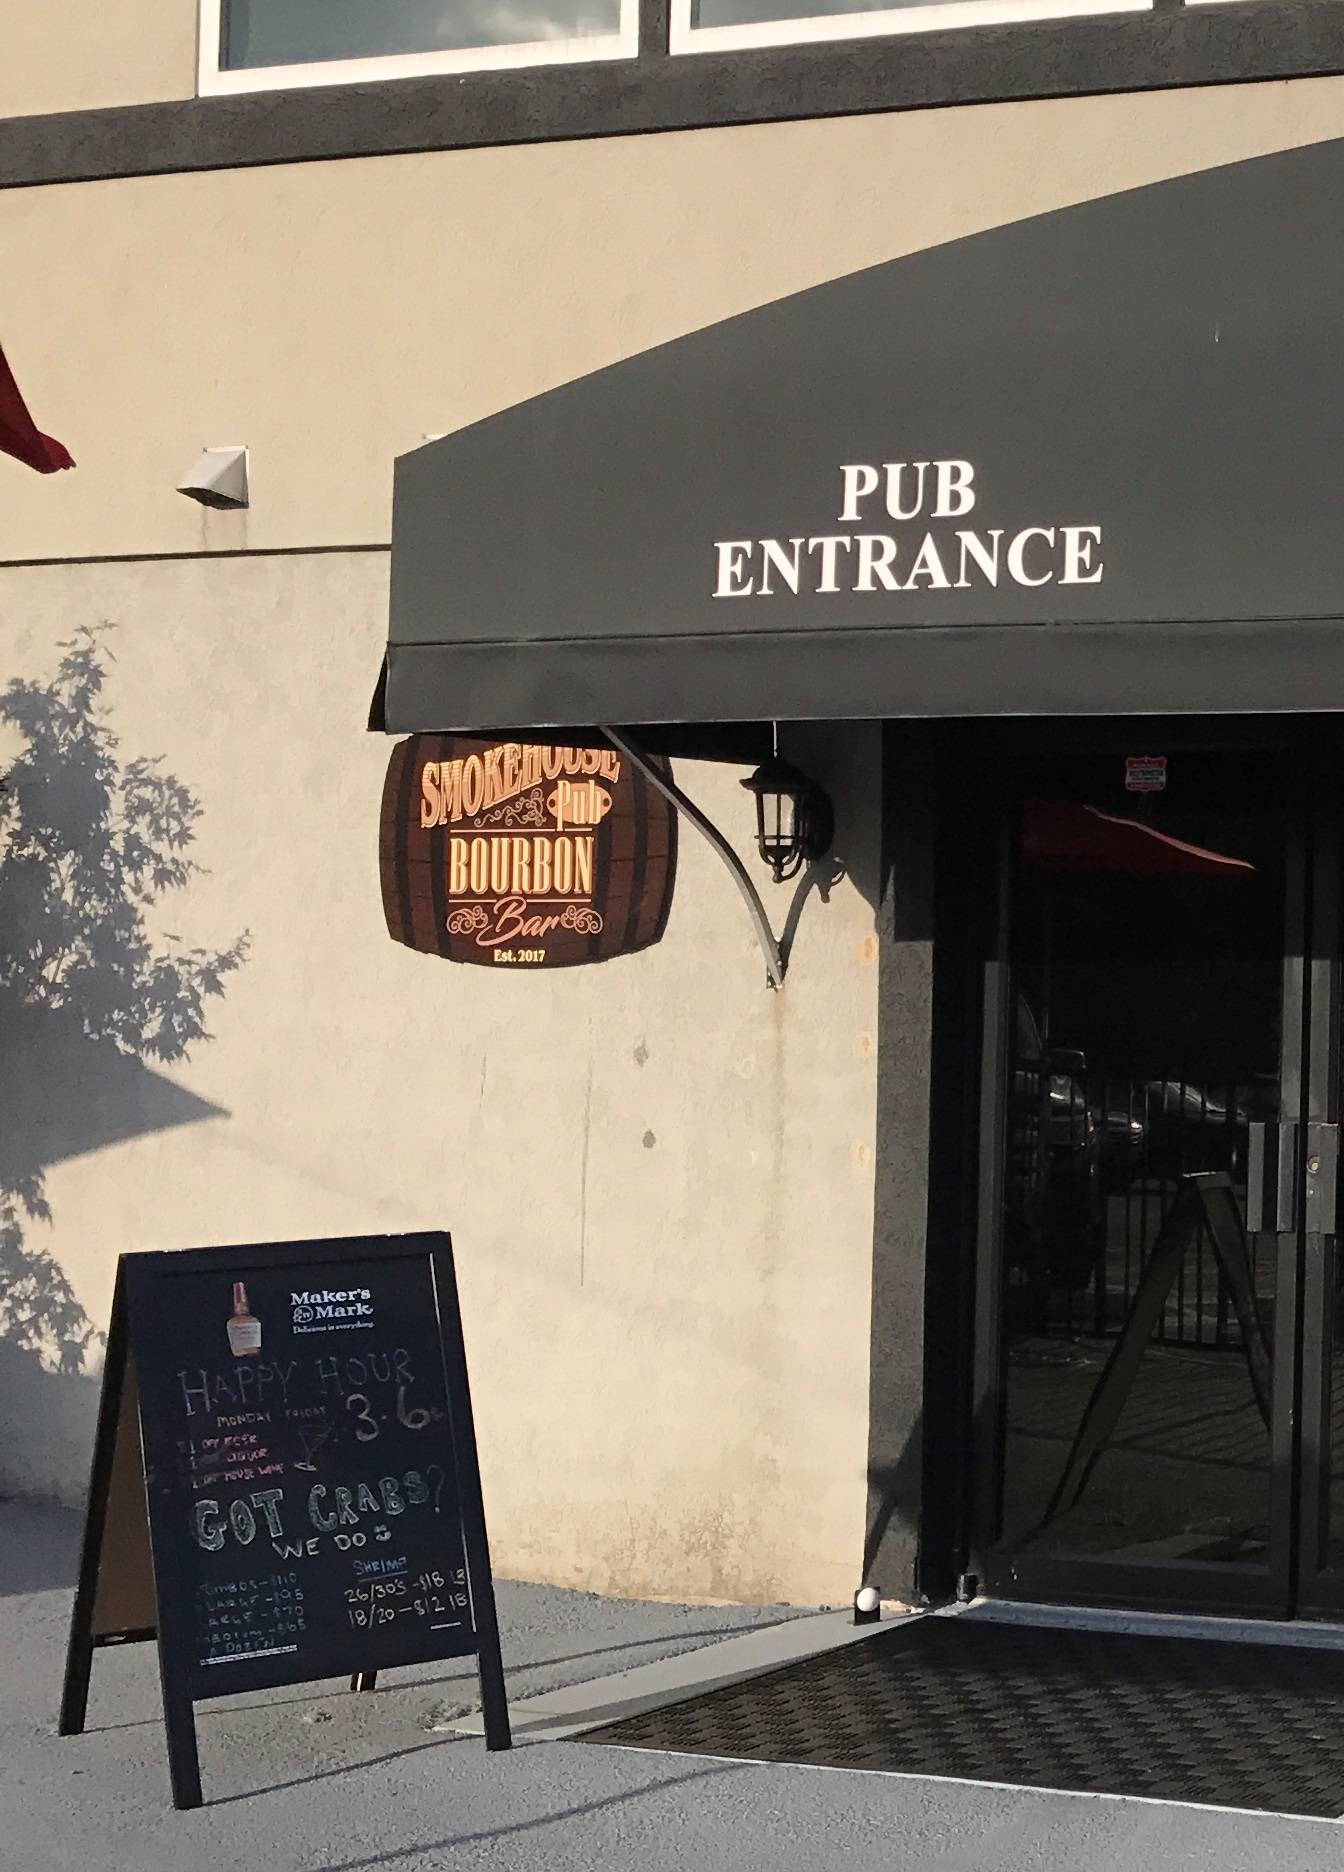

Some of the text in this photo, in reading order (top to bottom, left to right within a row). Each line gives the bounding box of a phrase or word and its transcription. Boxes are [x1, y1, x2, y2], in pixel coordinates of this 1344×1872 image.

[837, 460, 976, 521] PUB
[711, 526, 1104, 598] ENTRANCE
[421, 743, 621, 829] SMOKEHOUSE
[555, 779, 603, 832] Pub
[449, 835, 594, 896] BOURBON
[476, 895, 560, 946] Bar
[493, 948, 546, 963] Est. 2017
[290, 1288, 371, 1306] Maker's
[315, 1302, 374, 1320] Mark
[177, 1349, 415, 1417] HAPPY HOUR
[216, 1412, 272, 1429] MONDAY
[194, 1488, 284, 1553] GOT
[271, 1532, 368, 1561] WE DO
[353, 1556, 408, 1577] SHRIMP
[203, 1611, 254, 1628] ARGE
